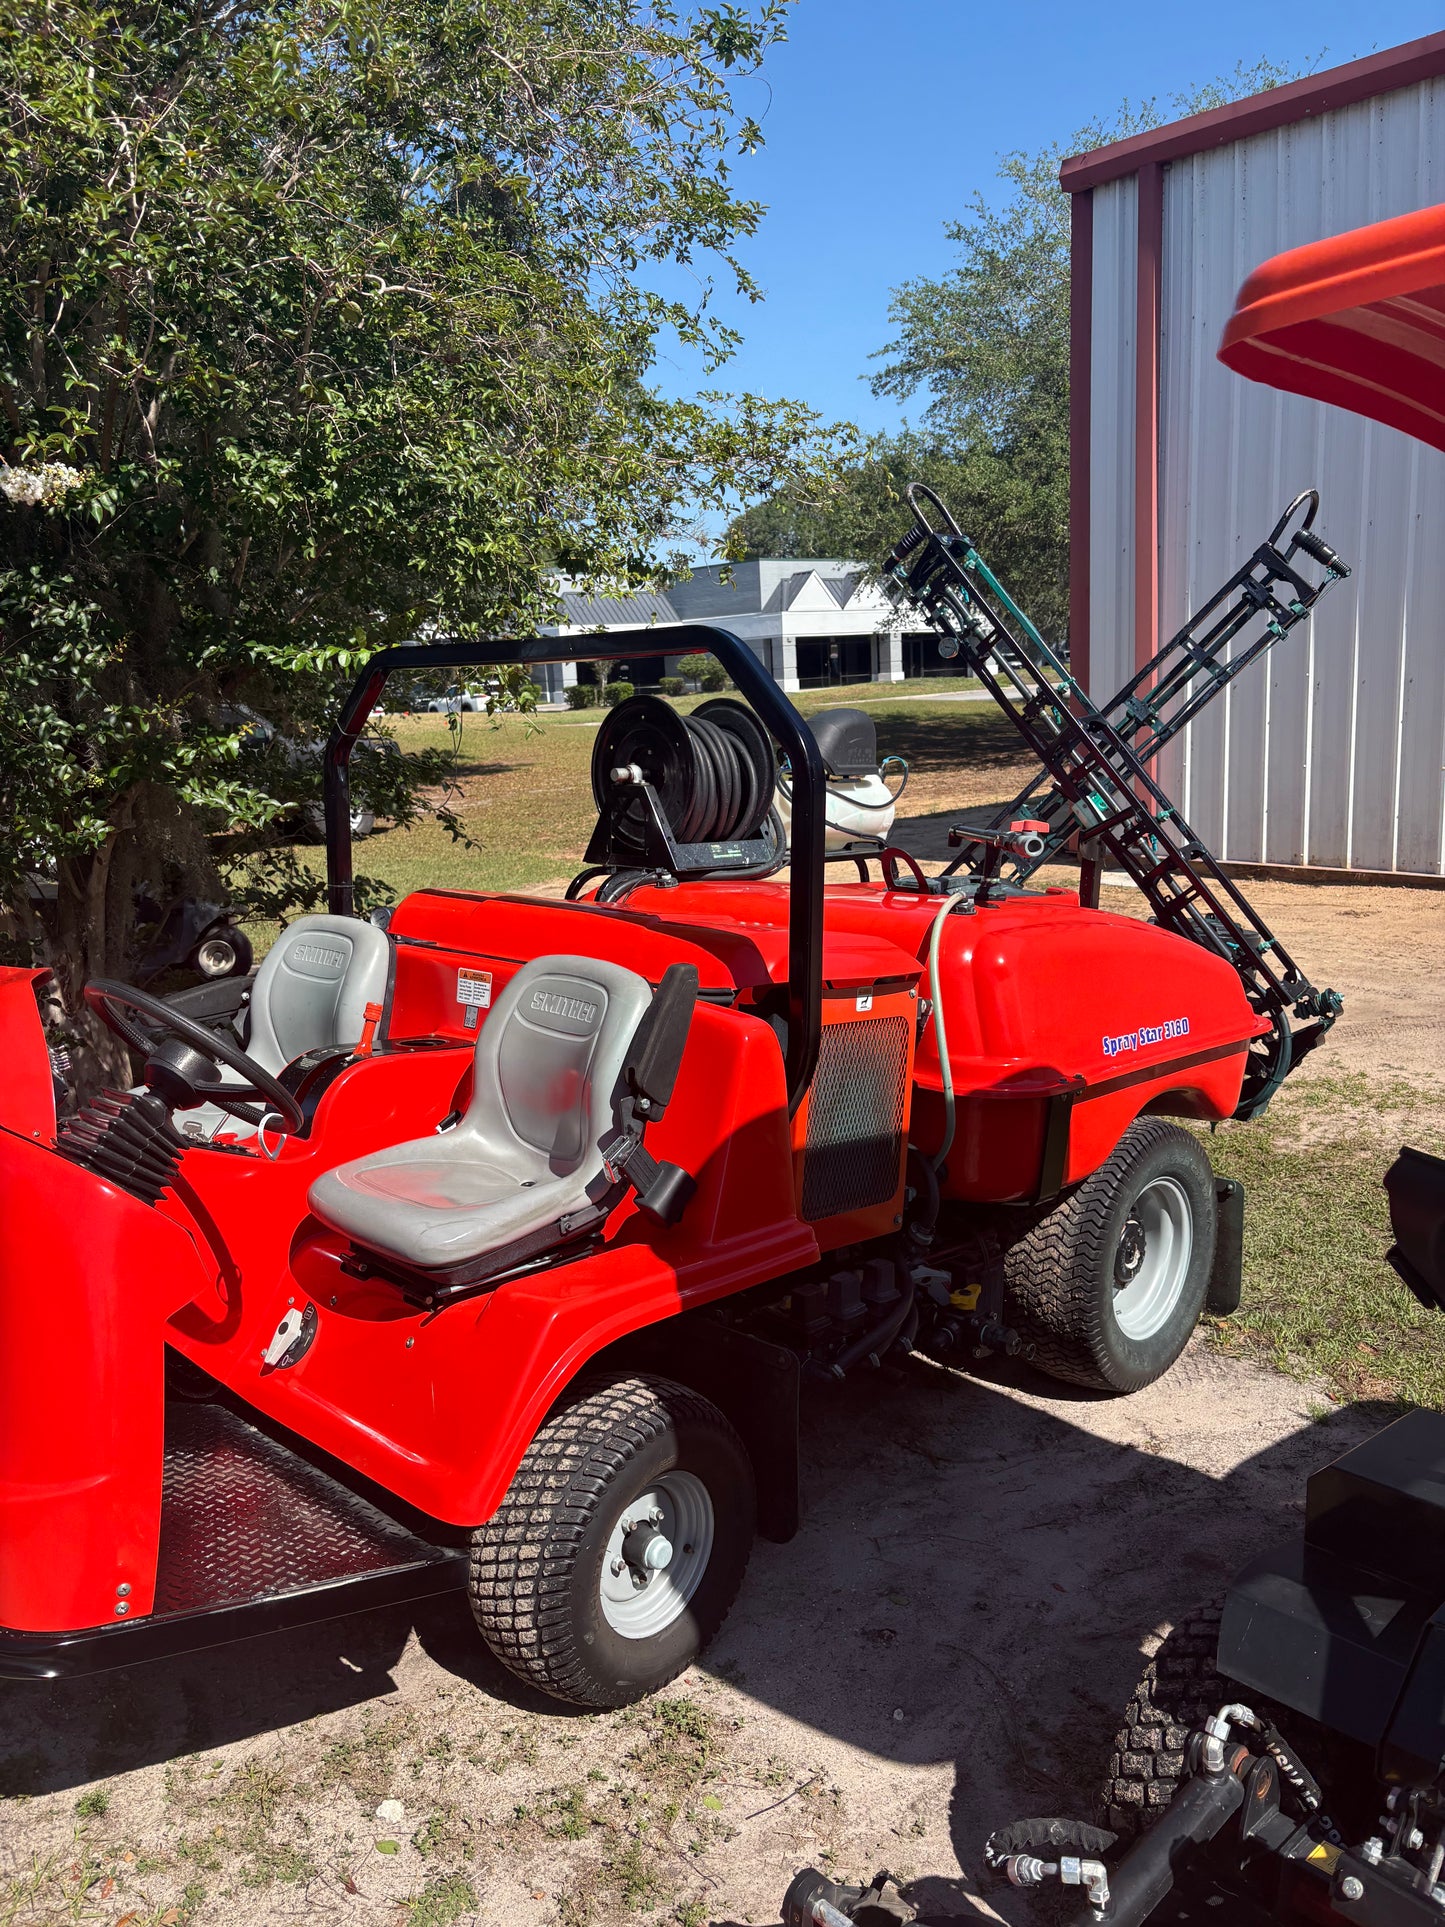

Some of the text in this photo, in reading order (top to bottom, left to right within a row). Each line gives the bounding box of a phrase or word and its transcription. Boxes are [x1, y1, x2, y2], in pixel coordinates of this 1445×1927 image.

[531, 991, 598, 1023] SMITHCO
[1103, 1017, 1190, 1057] Spray Star 3180
